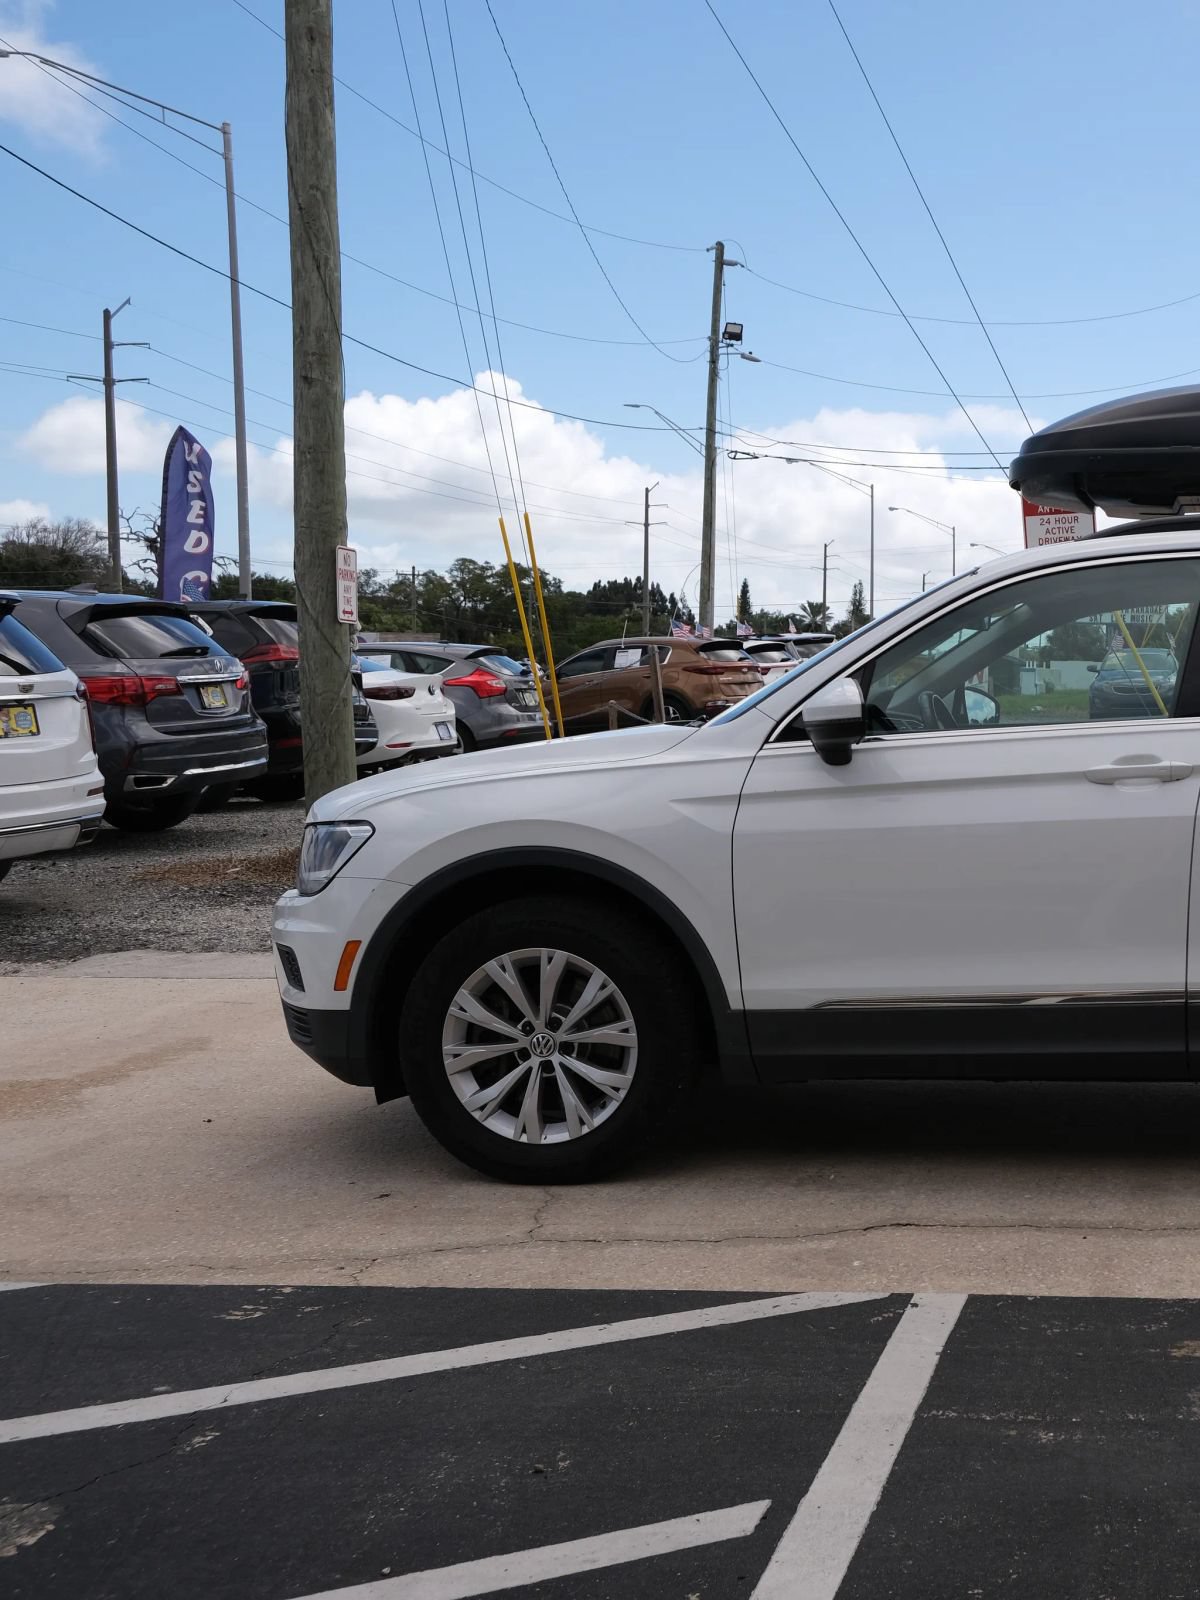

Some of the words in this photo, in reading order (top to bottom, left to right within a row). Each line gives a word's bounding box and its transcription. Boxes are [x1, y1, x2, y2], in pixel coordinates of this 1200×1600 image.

[181, 439, 209, 554] USED
[1039, 518, 1051, 526] 24
[1054, 516, 1079, 525] HOUR
[1045, 526, 1076, 535] ACTIVE
[343, 552, 352, 567] NO
[338, 567, 356, 583] PARKING
